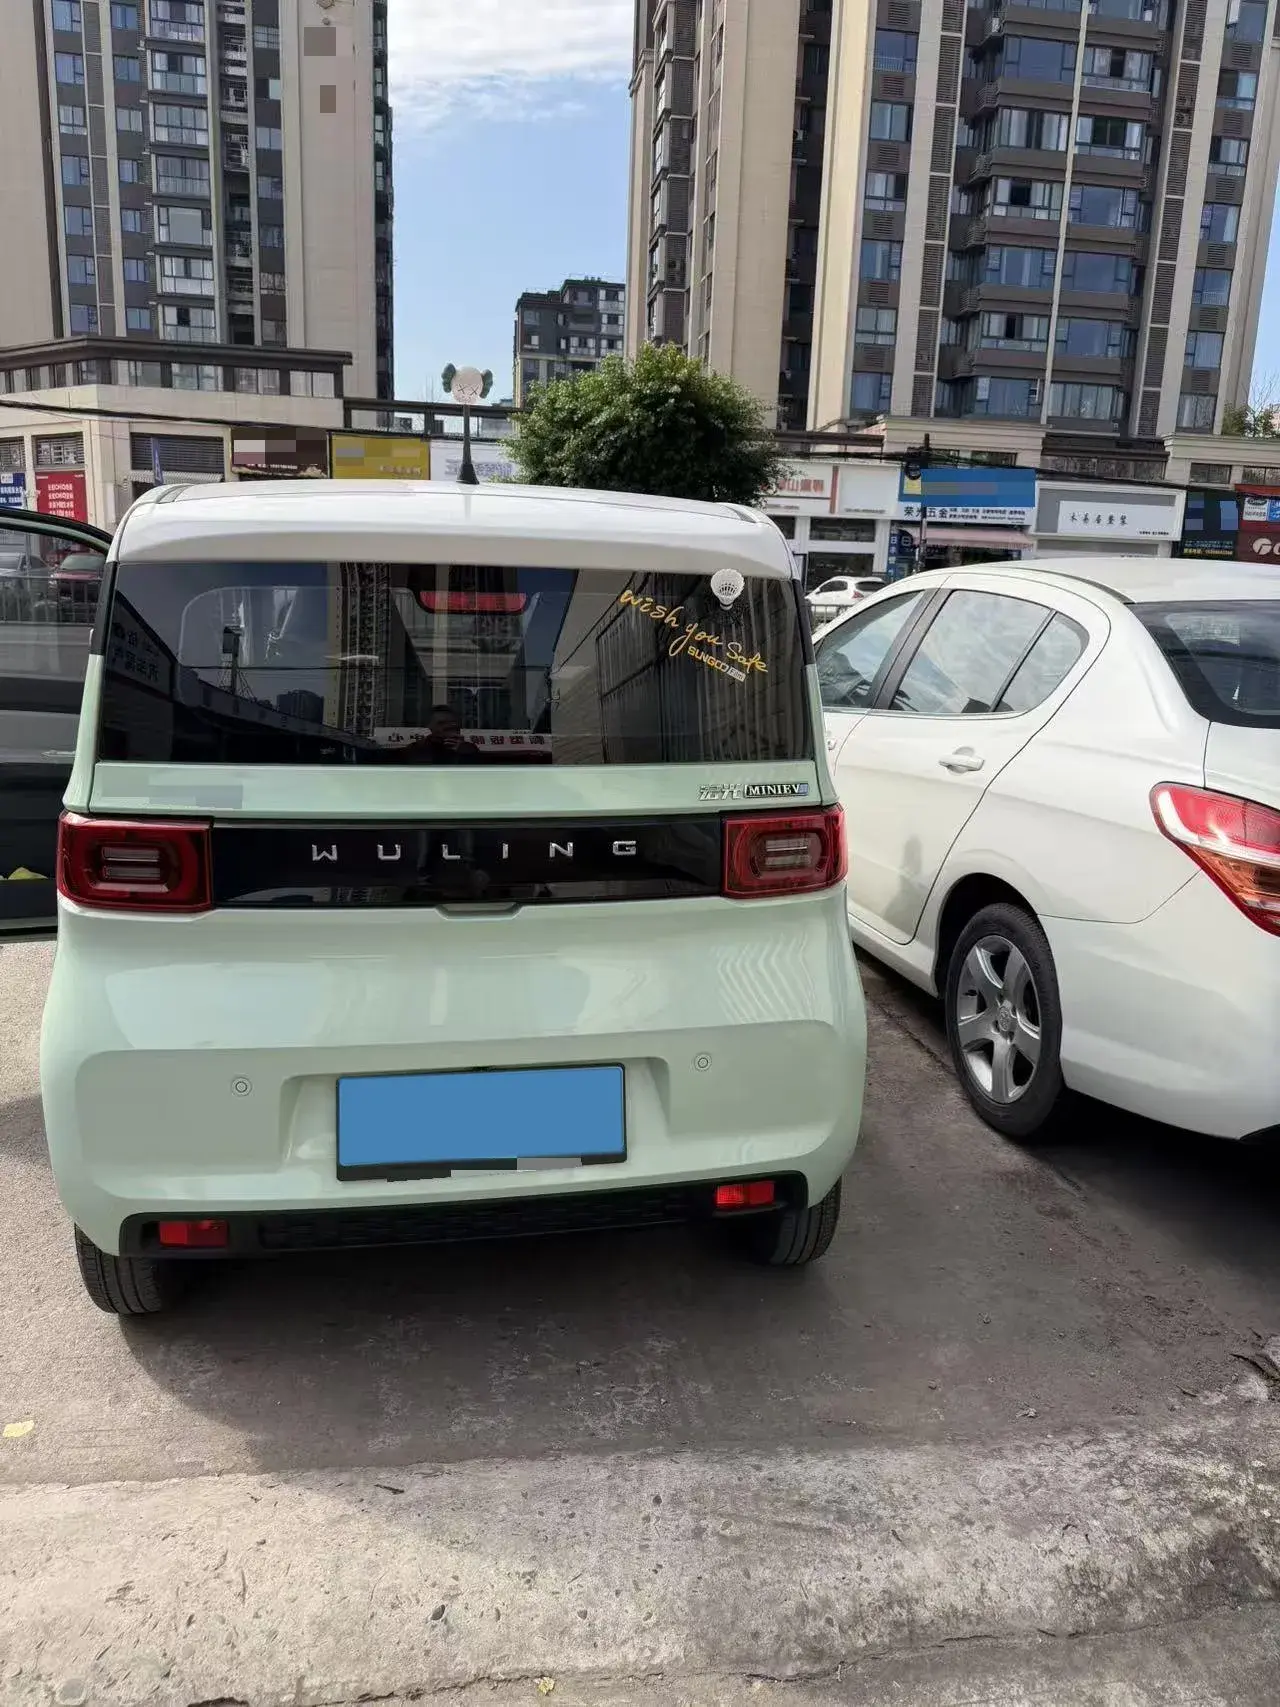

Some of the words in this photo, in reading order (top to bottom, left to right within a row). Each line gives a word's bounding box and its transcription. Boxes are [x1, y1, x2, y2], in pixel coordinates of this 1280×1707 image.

[619, 589, 684, 627] wish
[669, 622, 723, 656] you
[748, 784, 800, 797] MINIEV
[310, 840, 637, 862] WULING
